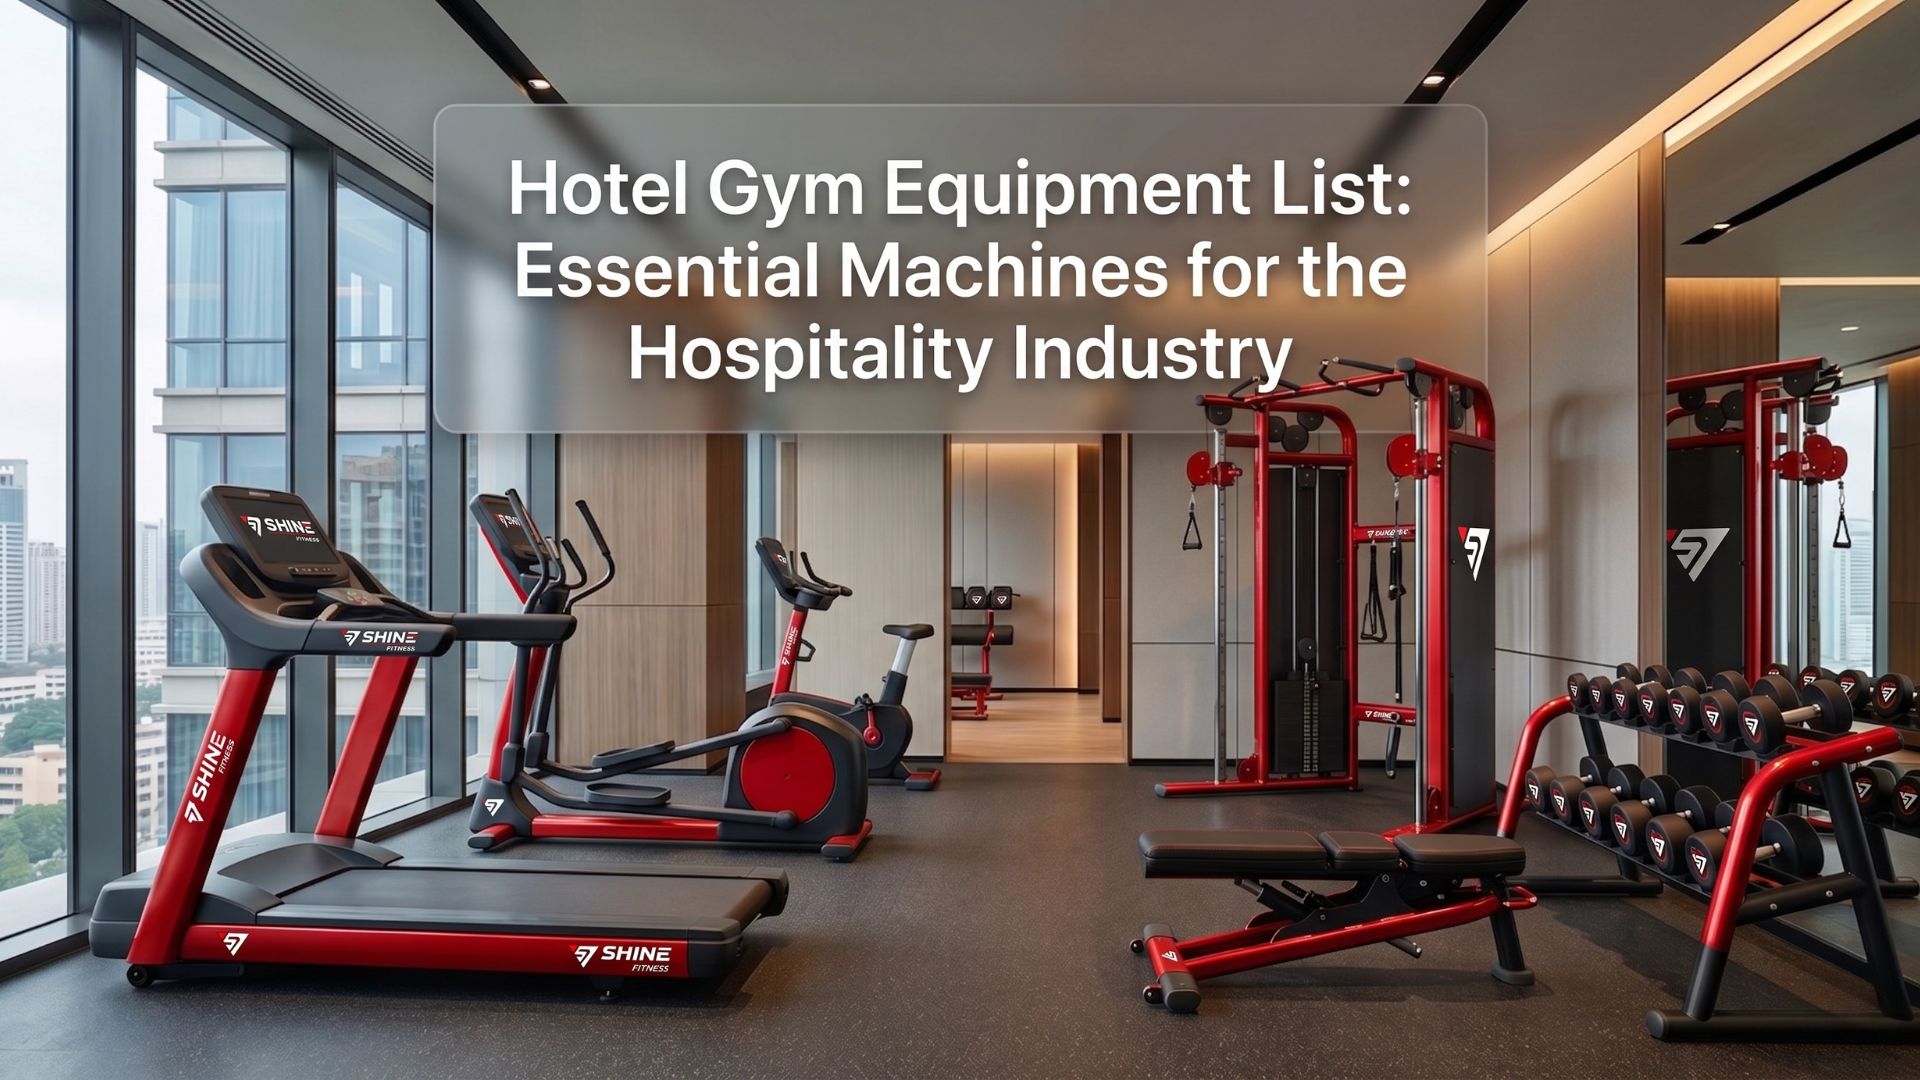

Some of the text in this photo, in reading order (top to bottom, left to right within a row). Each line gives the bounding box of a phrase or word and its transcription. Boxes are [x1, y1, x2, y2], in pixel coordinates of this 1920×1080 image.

[263, 517, 316, 535] SHINE
[361, 630, 418, 644] SHINE
[218, 738, 235, 774] FITNESS
[192, 730, 226, 802] SHINE
[600, 945, 672, 961] SHINE
[631, 964, 670, 973] FITNESS
